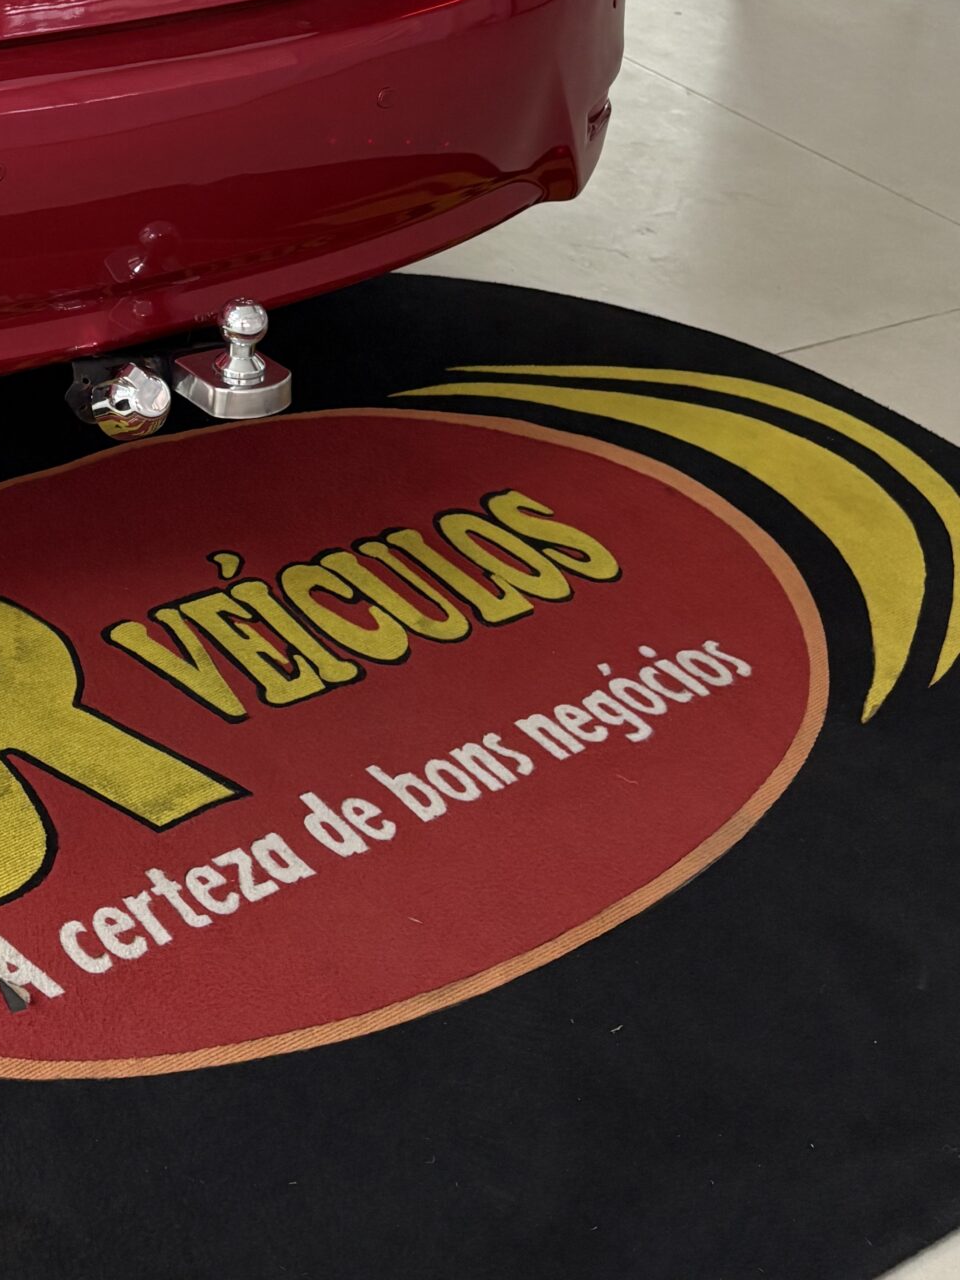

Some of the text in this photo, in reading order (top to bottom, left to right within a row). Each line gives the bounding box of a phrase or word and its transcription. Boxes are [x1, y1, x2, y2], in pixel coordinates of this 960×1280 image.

[102, 488, 622, 724] VEÍCULOS
[59, 832, 318, 975] certeza
[299, 791, 397, 858] de
[365, 732, 535, 823] bons
[514, 639, 753, 762] negócios
